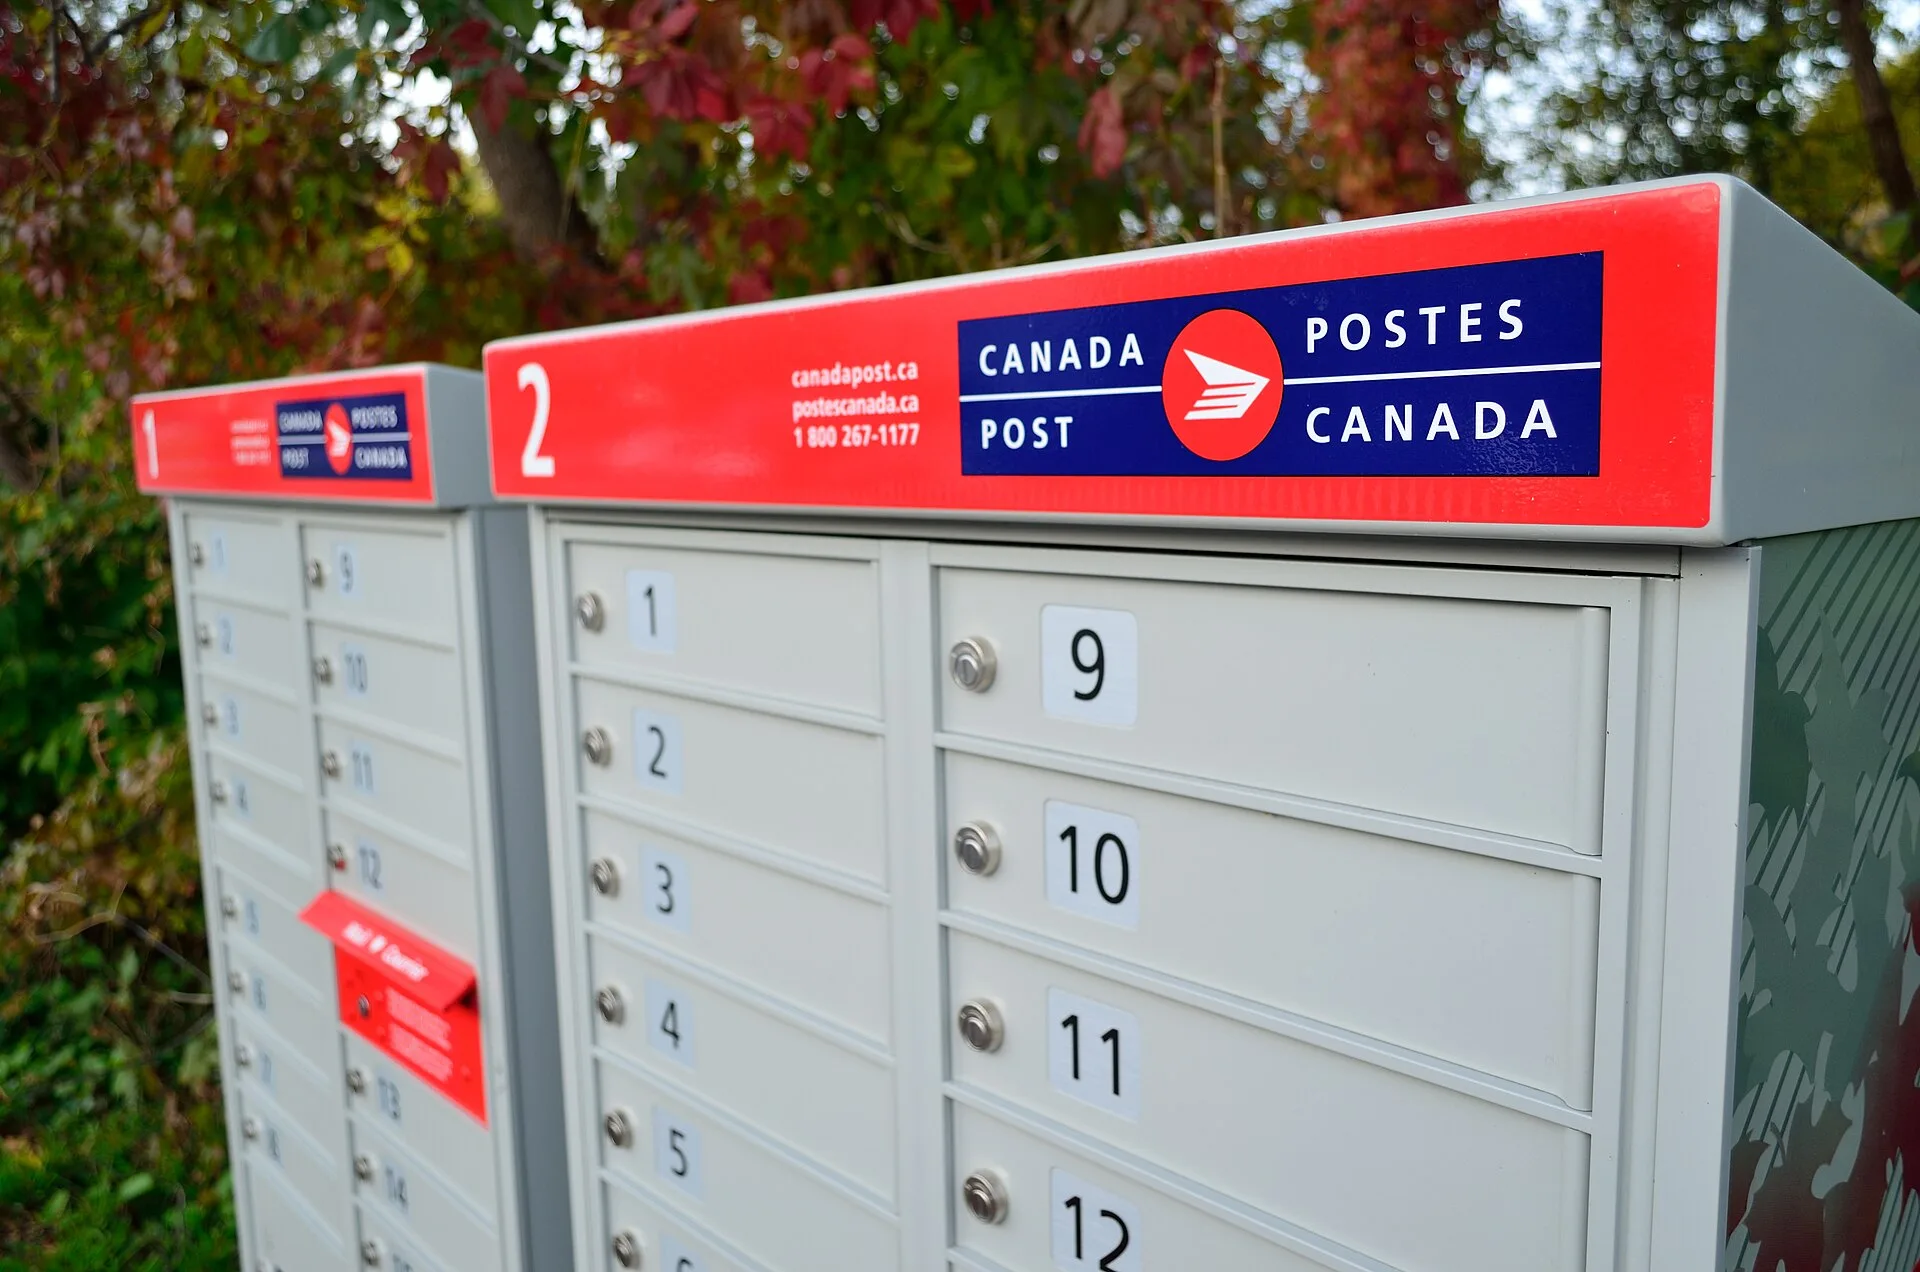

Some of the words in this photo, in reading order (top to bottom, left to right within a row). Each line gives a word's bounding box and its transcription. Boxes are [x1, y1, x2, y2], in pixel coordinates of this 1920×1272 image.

[1306, 298, 1525, 355] POSTES
[791, 360, 919, 389] canadapost.ca
[978, 332, 1145, 377] CANADA
[278, 410, 324, 433] CANADA
[517, 362, 556, 478] 2
[792, 390, 920, 423] postescanada.ca
[1305, 399, 1558, 444] CANADA
[142, 408, 159, 480] 1
[794, 426, 804, 448] 1
[807, 425, 838, 448] 800
[841, 423, 920, 448] 267-1177
[981, 415, 1074, 450] POST
[354, 446, 408, 470] CANADA
[339, 550, 354, 593] 9
[643, 585, 657, 637] 1
[343, 651, 367, 694] 10
[1070, 628, 1105, 702] 9
[350, 750, 371, 792] 11
[647, 725, 669, 780] 2
[357, 845, 380, 891] 12
[1059, 825, 1131, 905] 10
[654, 863, 676, 915] 3
[660, 1001, 682, 1050] 4
[1060, 1014, 1121, 1097] 11
[376, 1076, 399, 1121] 13
[667, 1129, 690, 1178] 5
[383, 1165, 407, 1210] 14
[1064, 1195, 1129, 1272] 12
